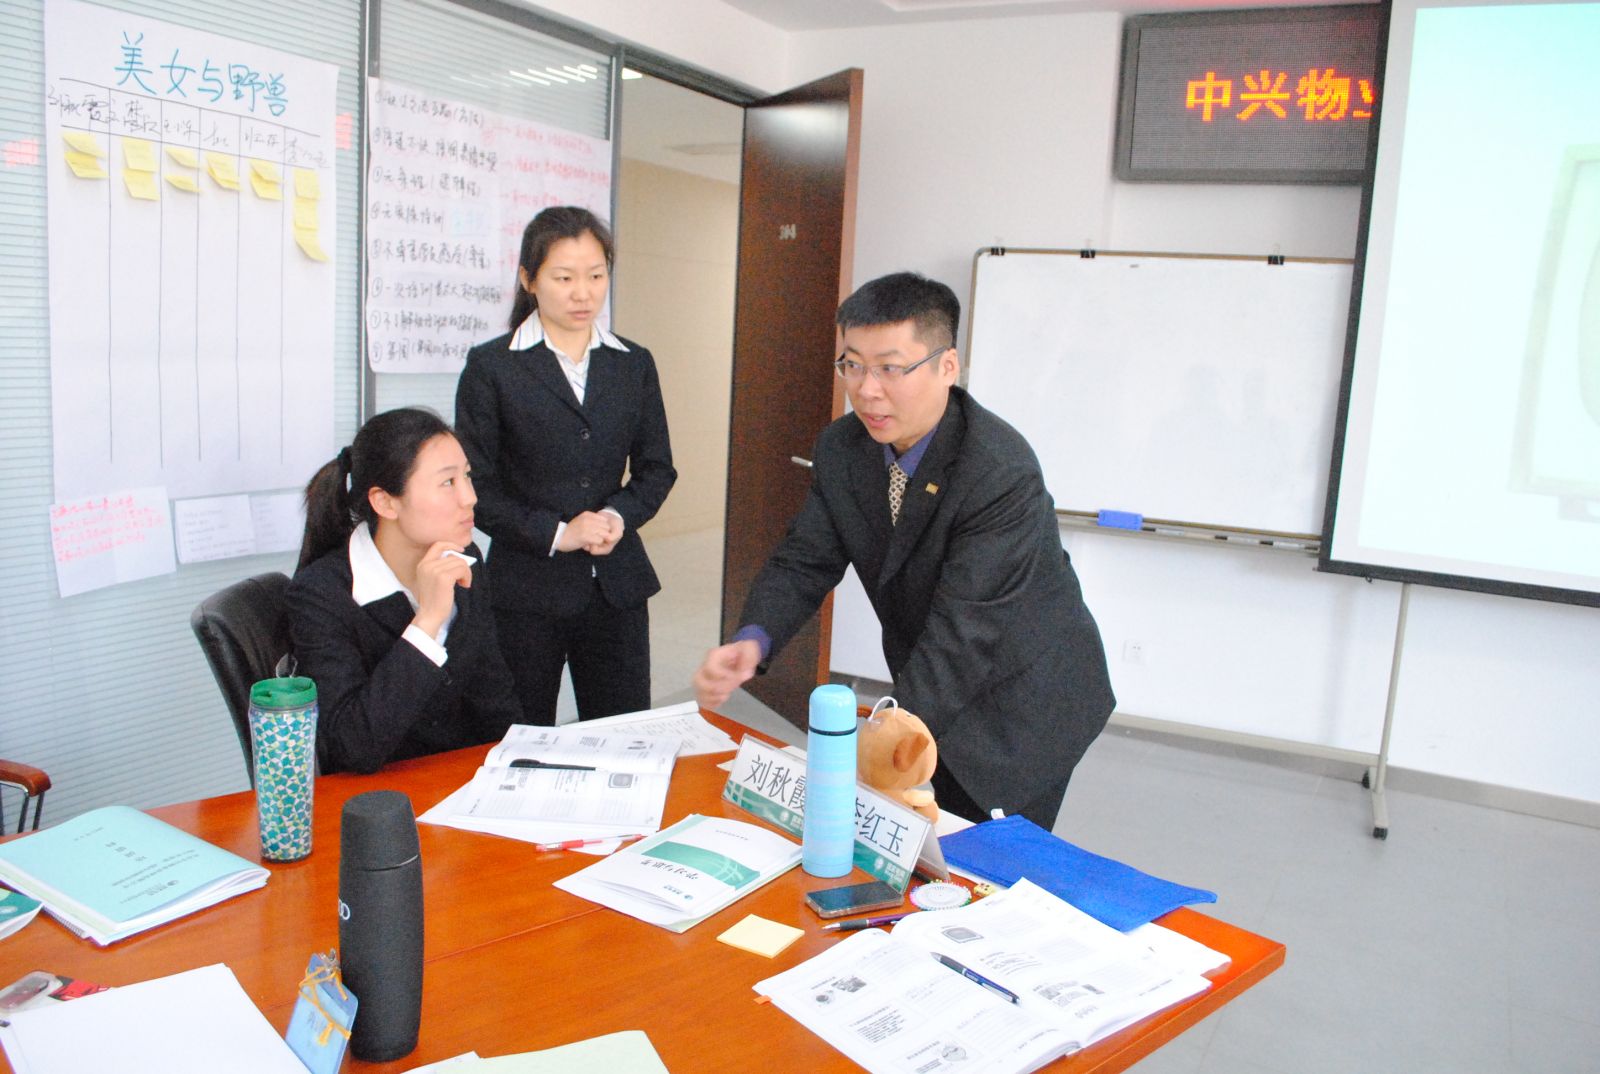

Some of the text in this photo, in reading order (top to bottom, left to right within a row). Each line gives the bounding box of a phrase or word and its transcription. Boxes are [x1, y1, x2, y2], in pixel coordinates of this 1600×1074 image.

[114, 31, 288, 116] 美女与野兽
